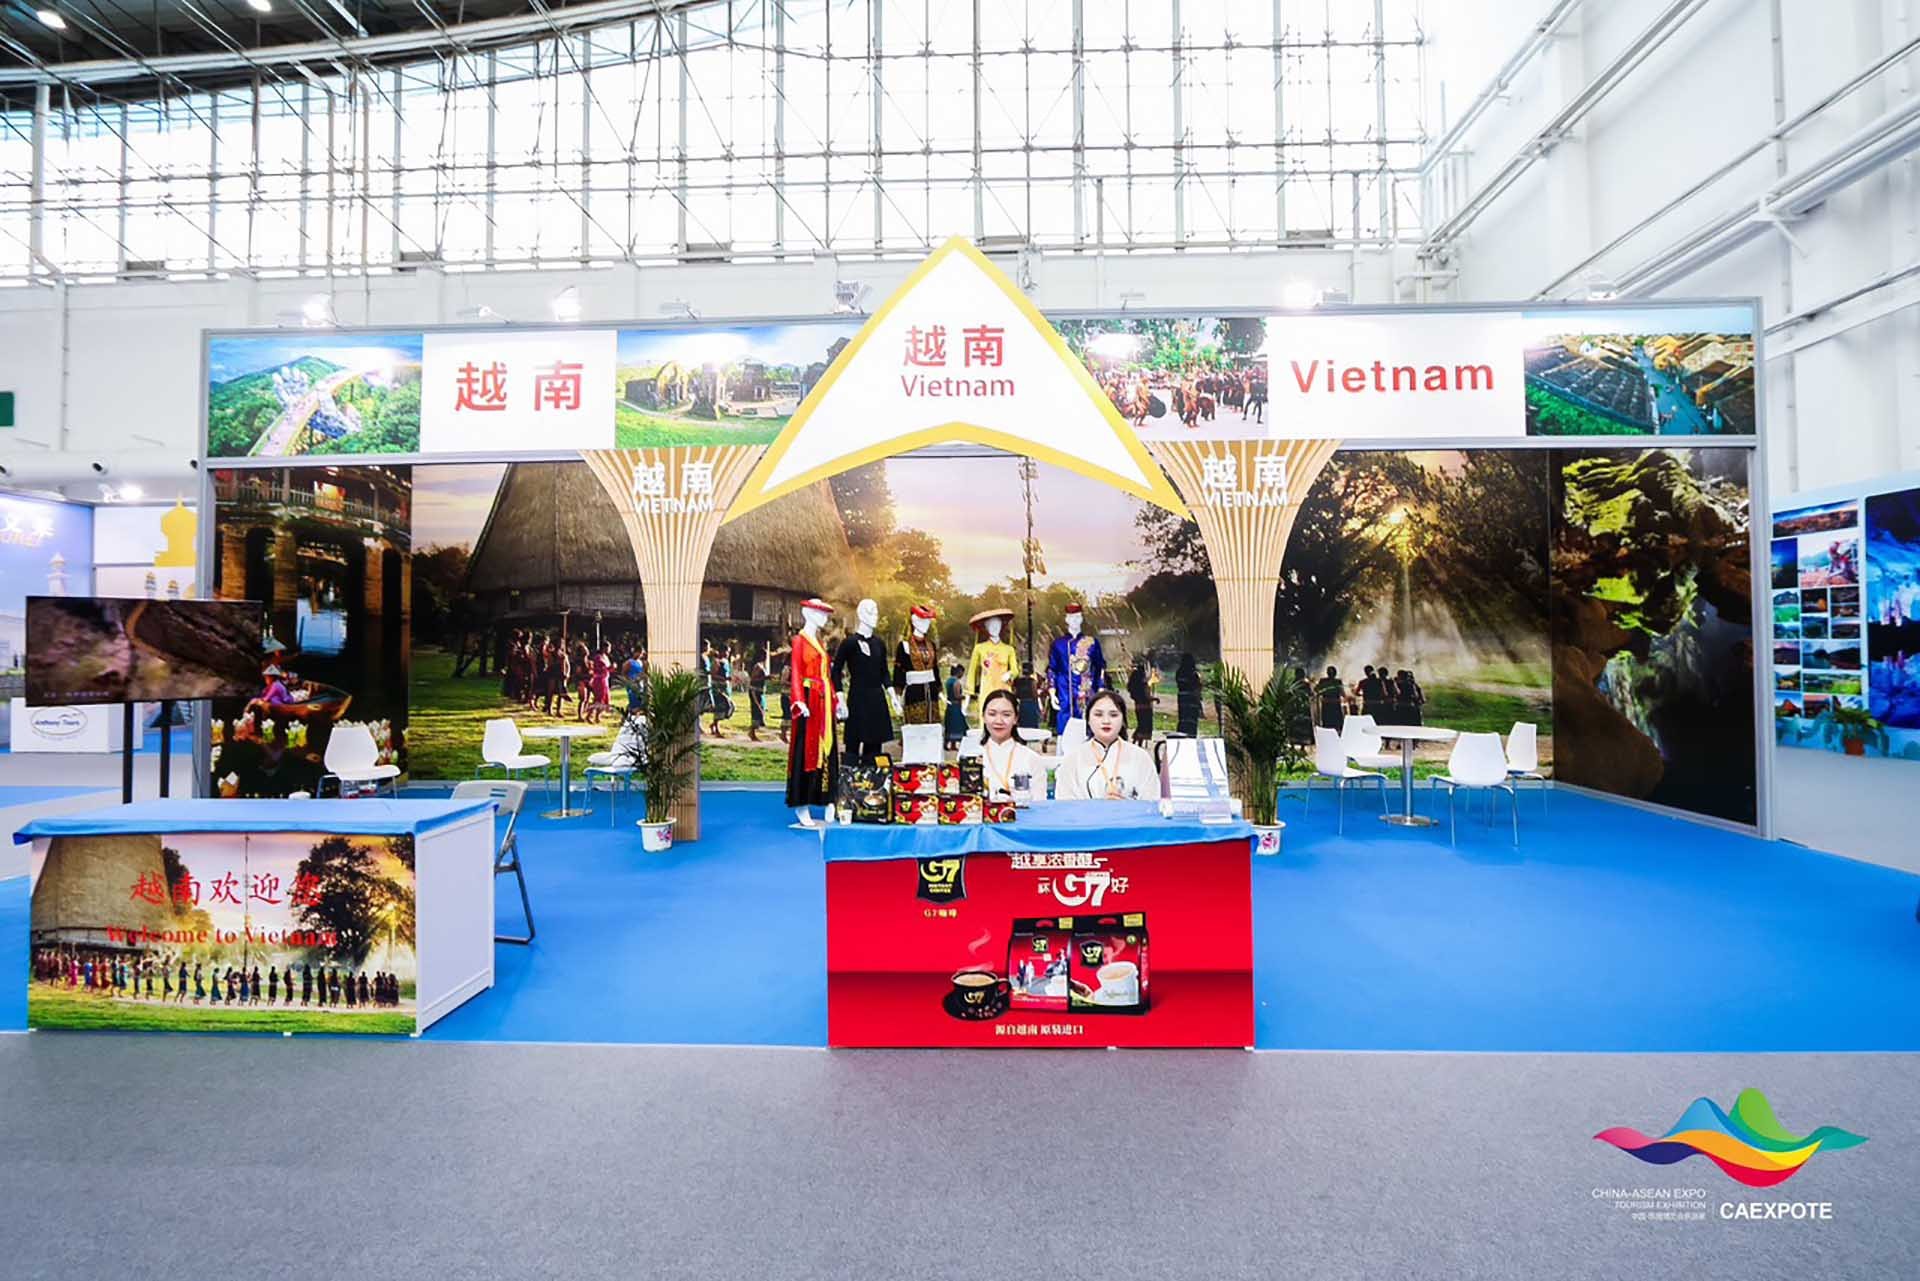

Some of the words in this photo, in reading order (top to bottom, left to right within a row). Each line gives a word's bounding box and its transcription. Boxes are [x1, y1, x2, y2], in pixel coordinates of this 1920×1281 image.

[903, 324, 1004, 367] 越南
[455, 360, 583, 411] 越南
[901, 374, 1014, 397] Vietnam
[1290, 359, 1493, 393] Vietnam
[633, 461, 713, 495] 越南
[1203, 454, 1288, 489] 越南
[633, 497, 713, 513] VIETNAM
[1204, 490, 1288, 507] VIETNAM
[920, 859, 960, 883] G7
[130, 871, 323, 907] 越南欢迎您
[1052, 870, 1110, 907] G7
[1111, 877, 1129, 893] 好
[106, 924, 209, 945] Welcome
[215, 928, 240, 945] to
[244, 925, 338, 946] Vietnam
